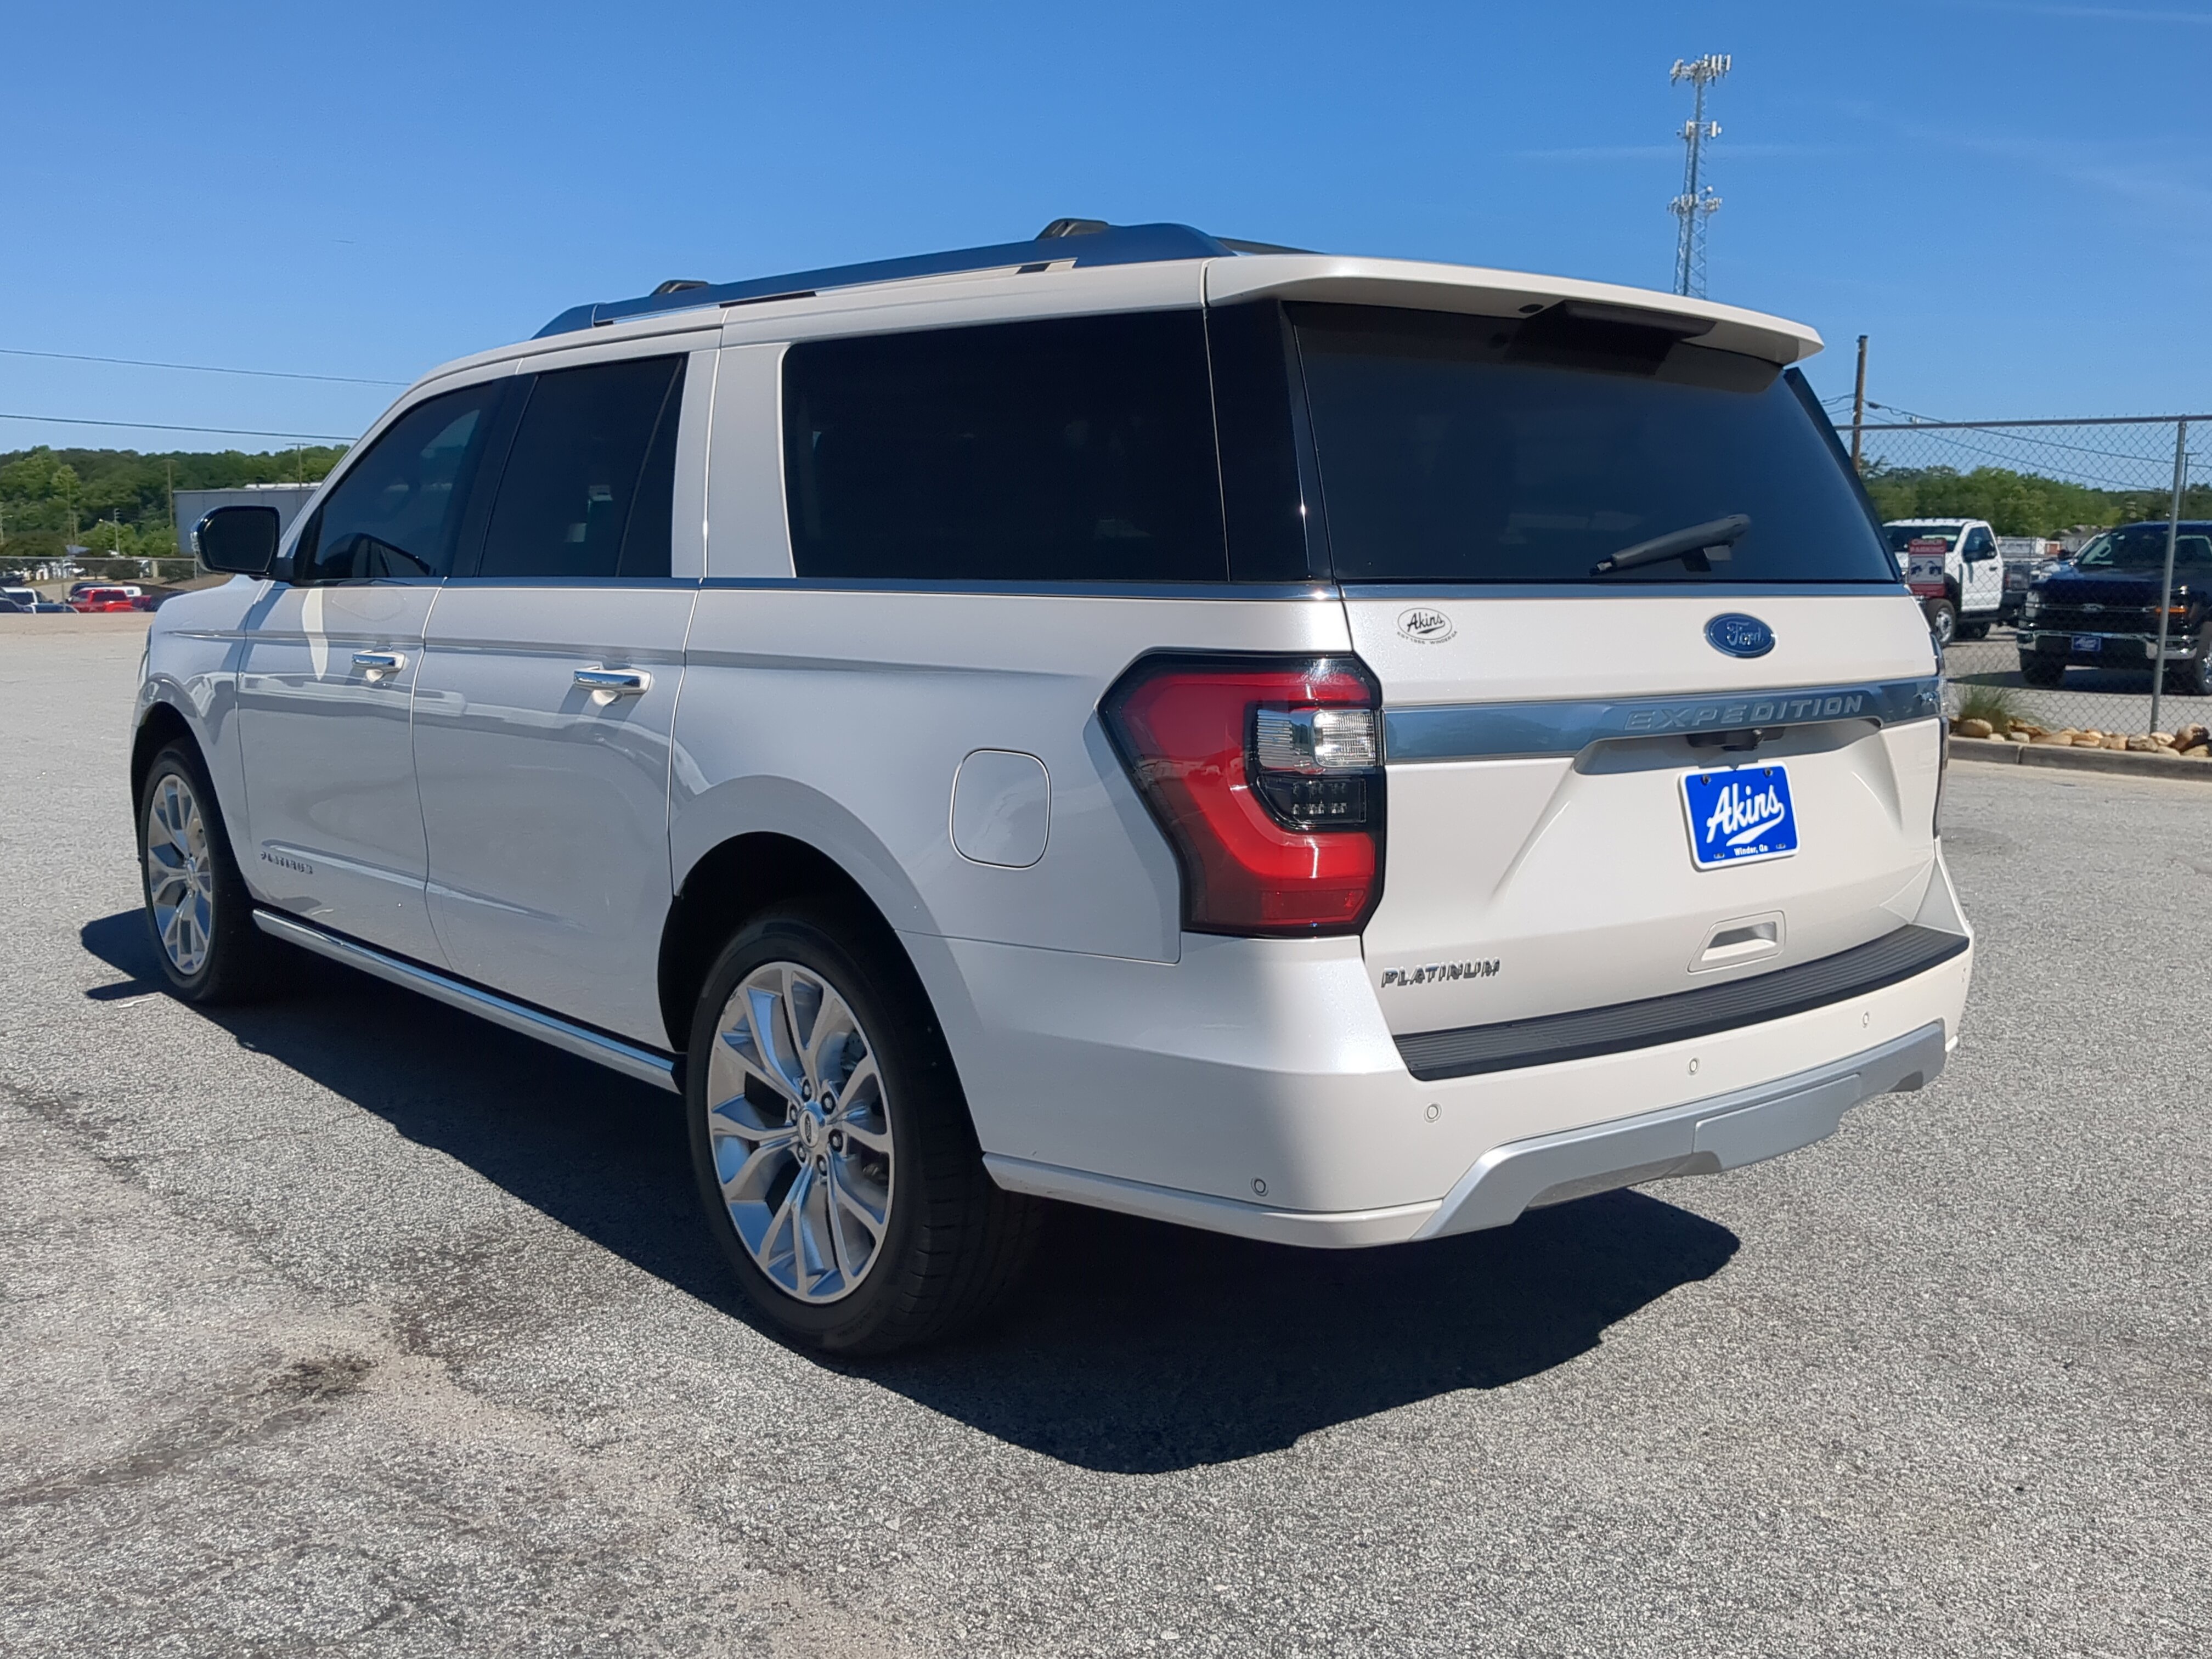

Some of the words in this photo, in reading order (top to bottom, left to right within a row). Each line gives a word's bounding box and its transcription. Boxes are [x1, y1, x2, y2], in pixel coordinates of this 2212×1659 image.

[1397, 631, 1409, 640] EST
[1407, 612, 1445, 634] Akins
[1726, 621, 1764, 646] Ford
[1624, 695, 1863, 730] EXPEDITION
[1706, 782, 1785, 847] Akins
[1734, 846, 1758, 856] Winder,
[1759, 844, 1768, 853] Ga
[1381, 957, 1500, 988] PLATINUM
